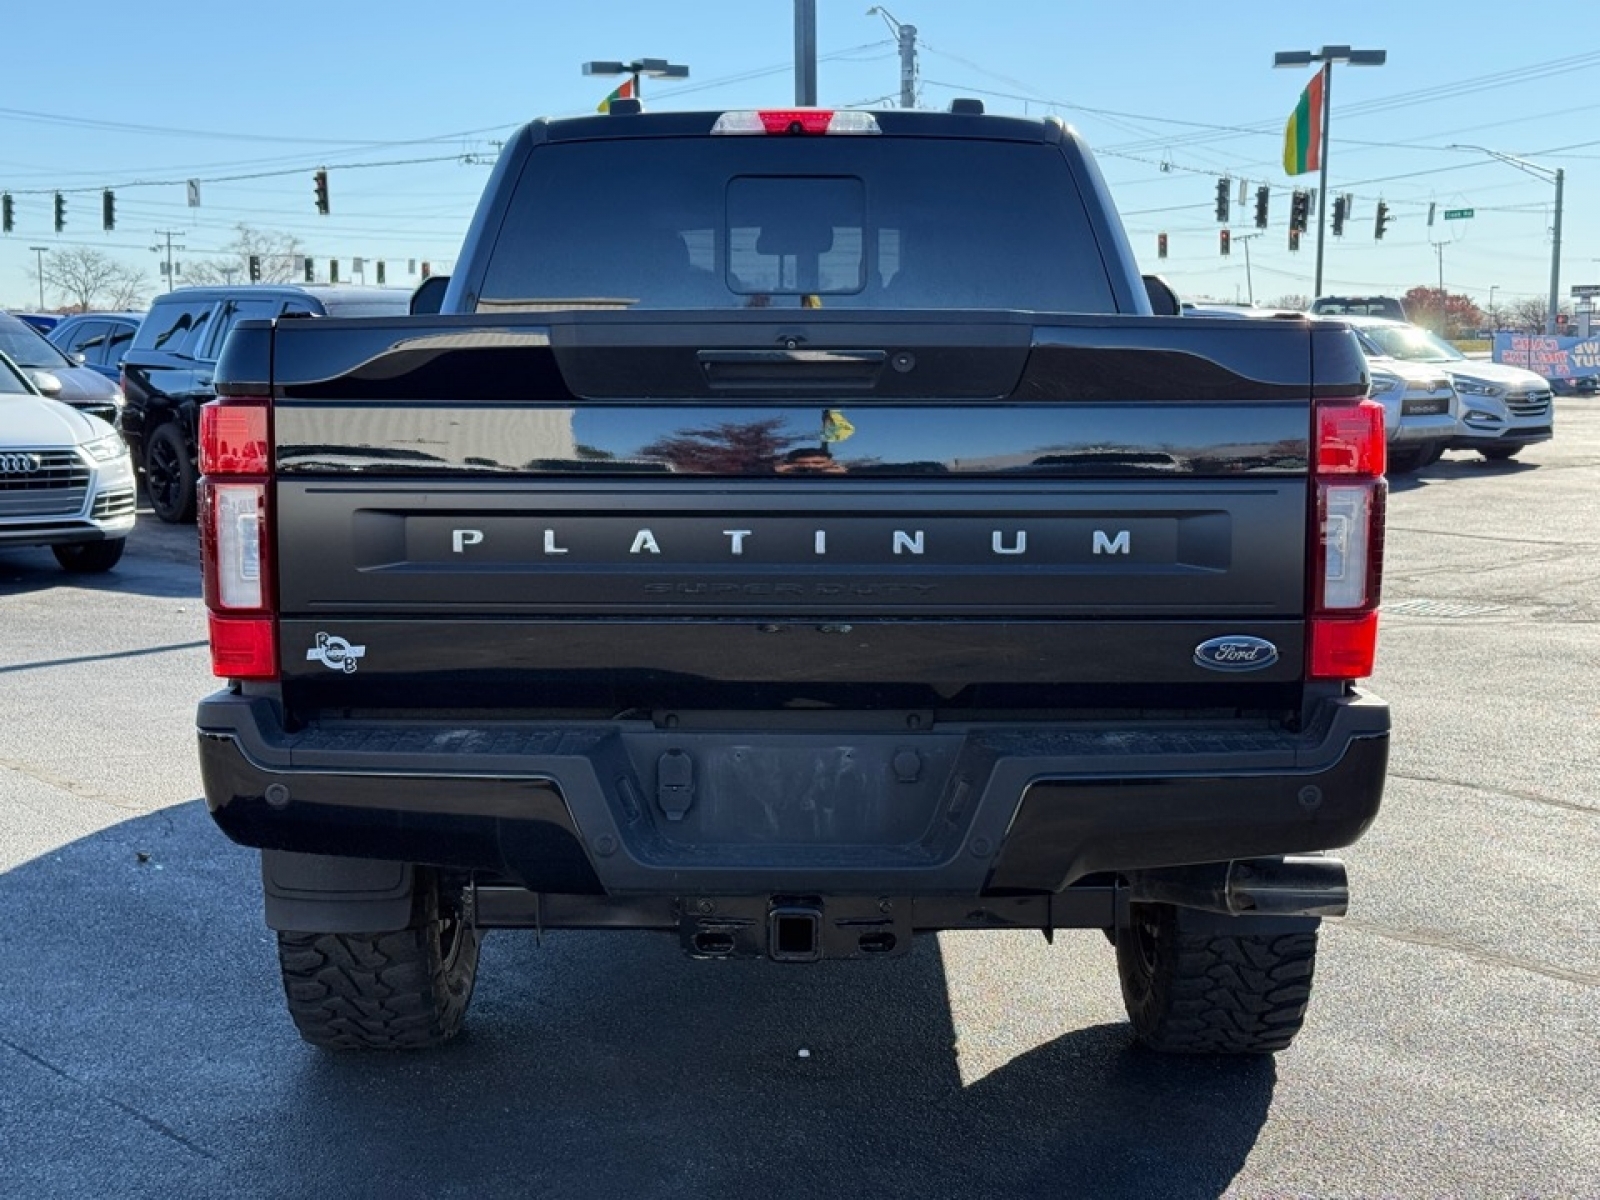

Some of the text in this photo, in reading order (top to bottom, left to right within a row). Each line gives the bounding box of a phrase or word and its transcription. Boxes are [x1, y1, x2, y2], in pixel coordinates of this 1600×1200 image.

[452, 529, 1131, 555] PLATINUM
[643, 582, 938, 596] SUPER DUTY
[1214, 643, 1266, 661] Ford
